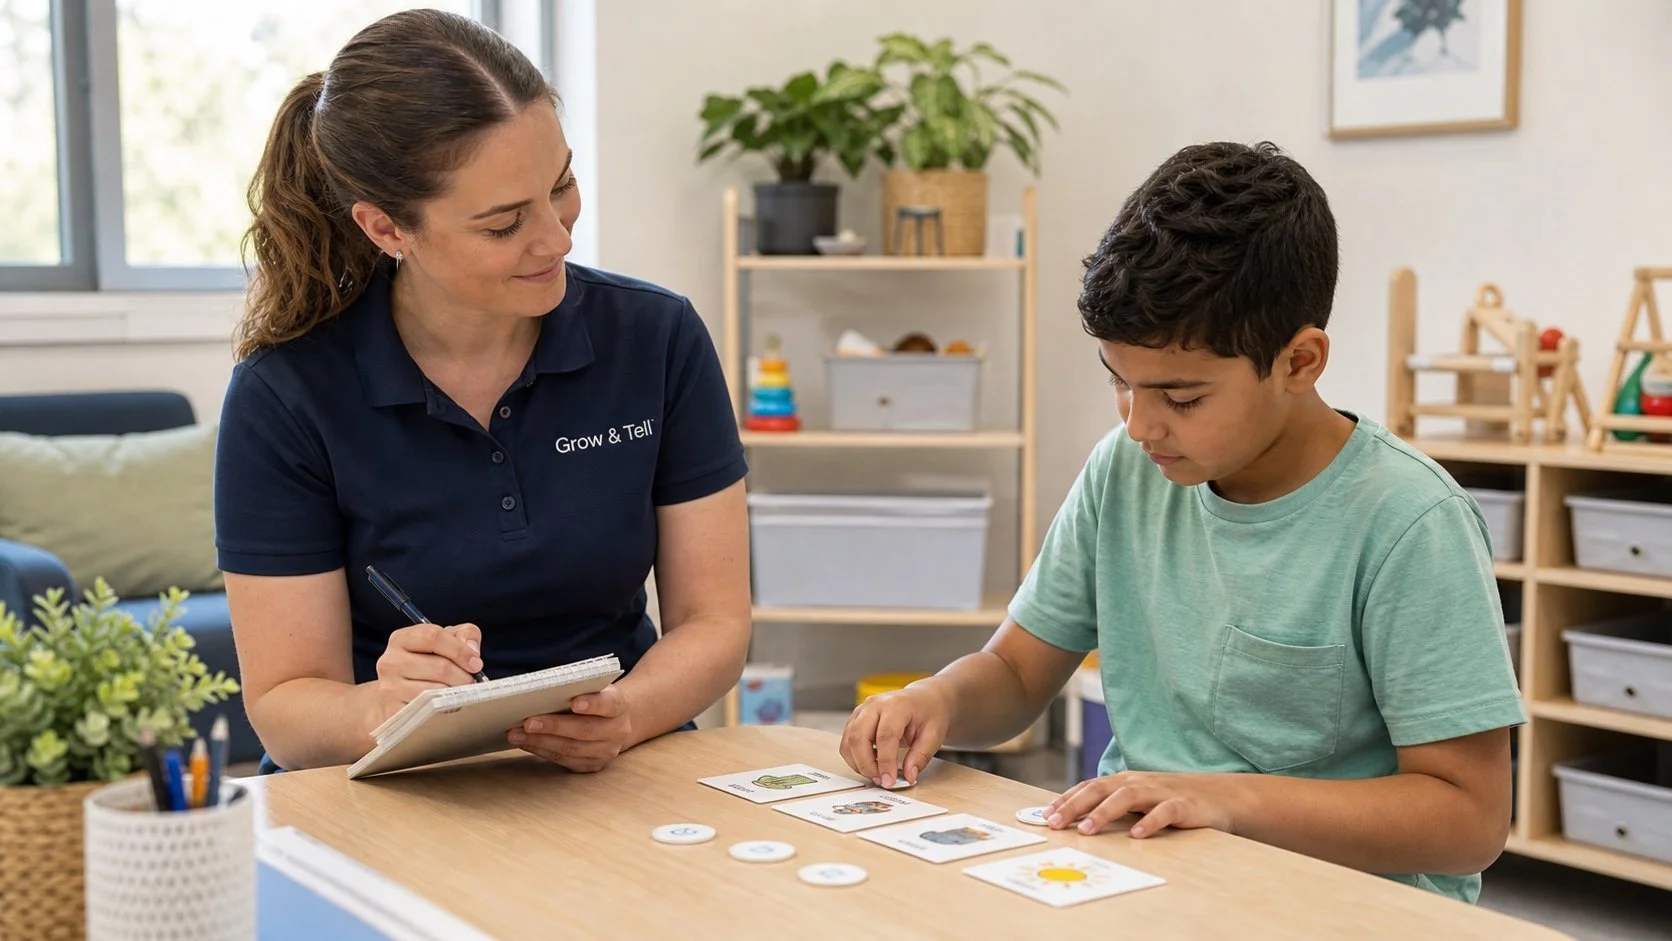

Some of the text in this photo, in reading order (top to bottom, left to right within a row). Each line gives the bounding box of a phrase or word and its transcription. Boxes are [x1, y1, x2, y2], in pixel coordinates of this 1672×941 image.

[555, 419, 653, 453] Grow & Tell
